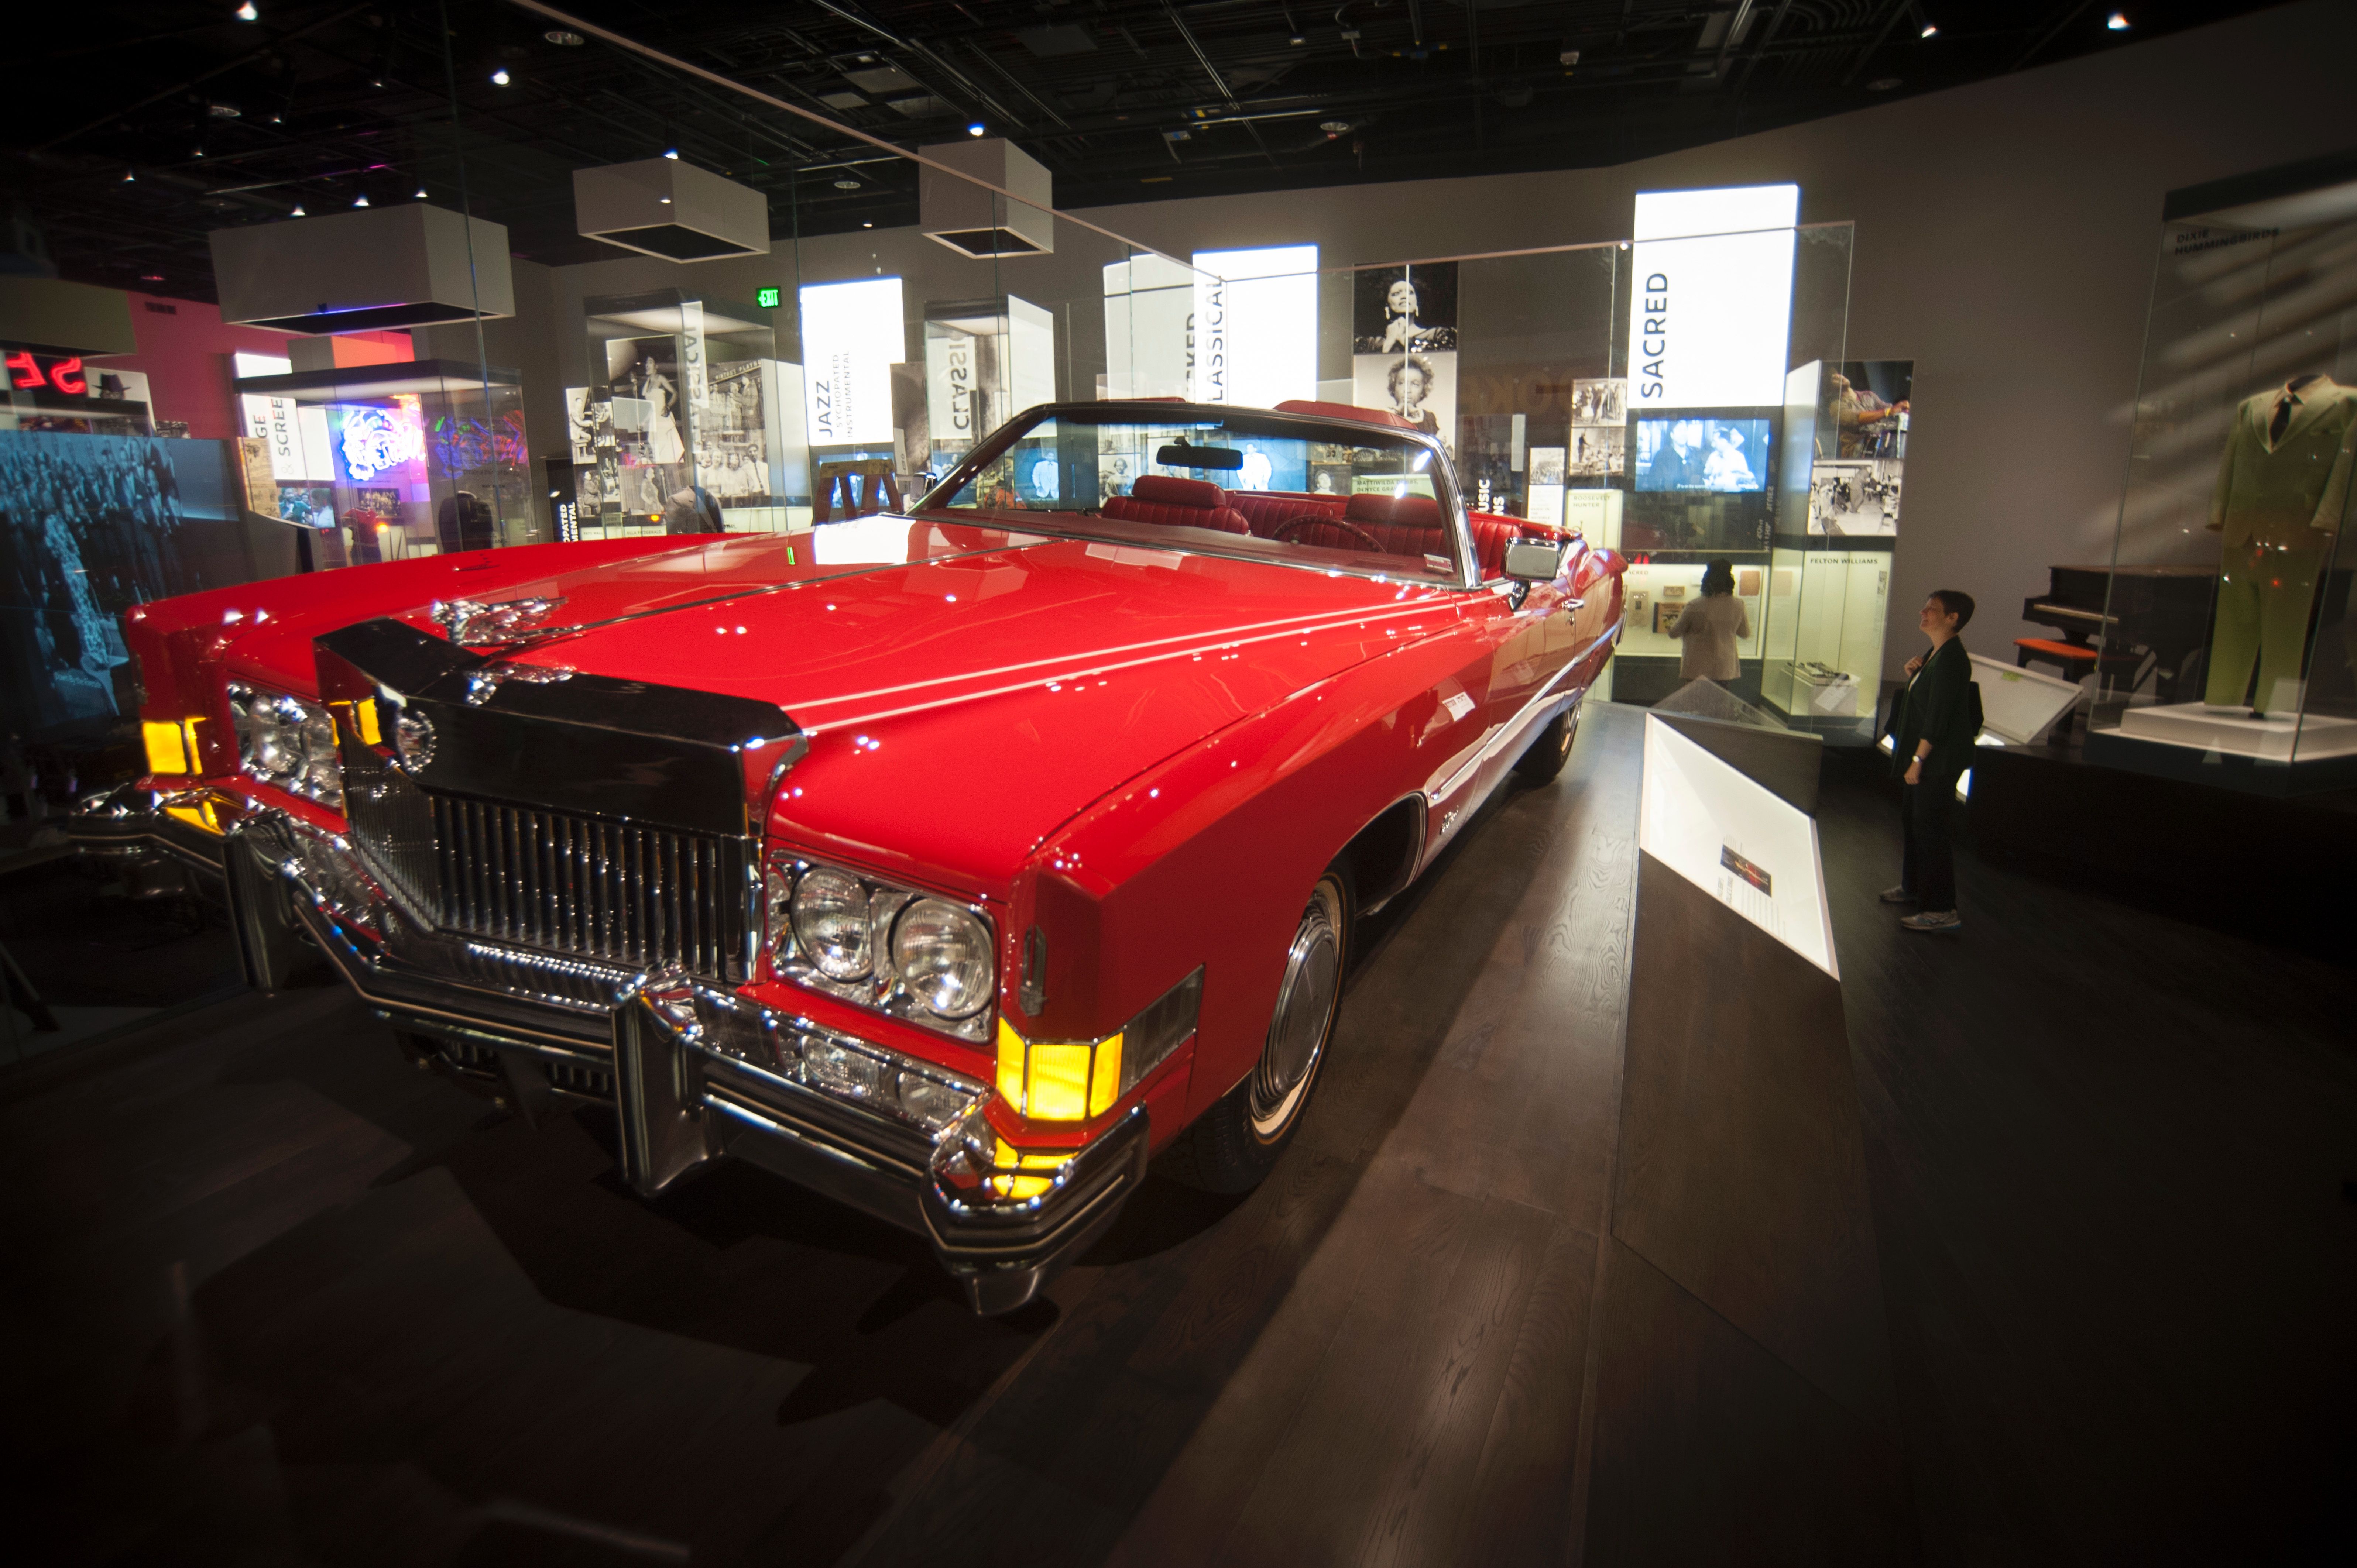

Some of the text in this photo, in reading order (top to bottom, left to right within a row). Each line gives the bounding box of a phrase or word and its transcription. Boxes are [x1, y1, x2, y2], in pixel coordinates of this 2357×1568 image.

[2175, 228, 2280, 255] HUMMINGBIRDS
[2176, 229, 2209, 243] DIXIE
[761, 290, 778, 307] EXIT
[1641, 273, 1668, 399] SACRED
[816, 380, 832, 438] JAZZ
[843, 351, 853, 438] INSTRUMENTAL
[1478, 479, 1490, 512] USIC
